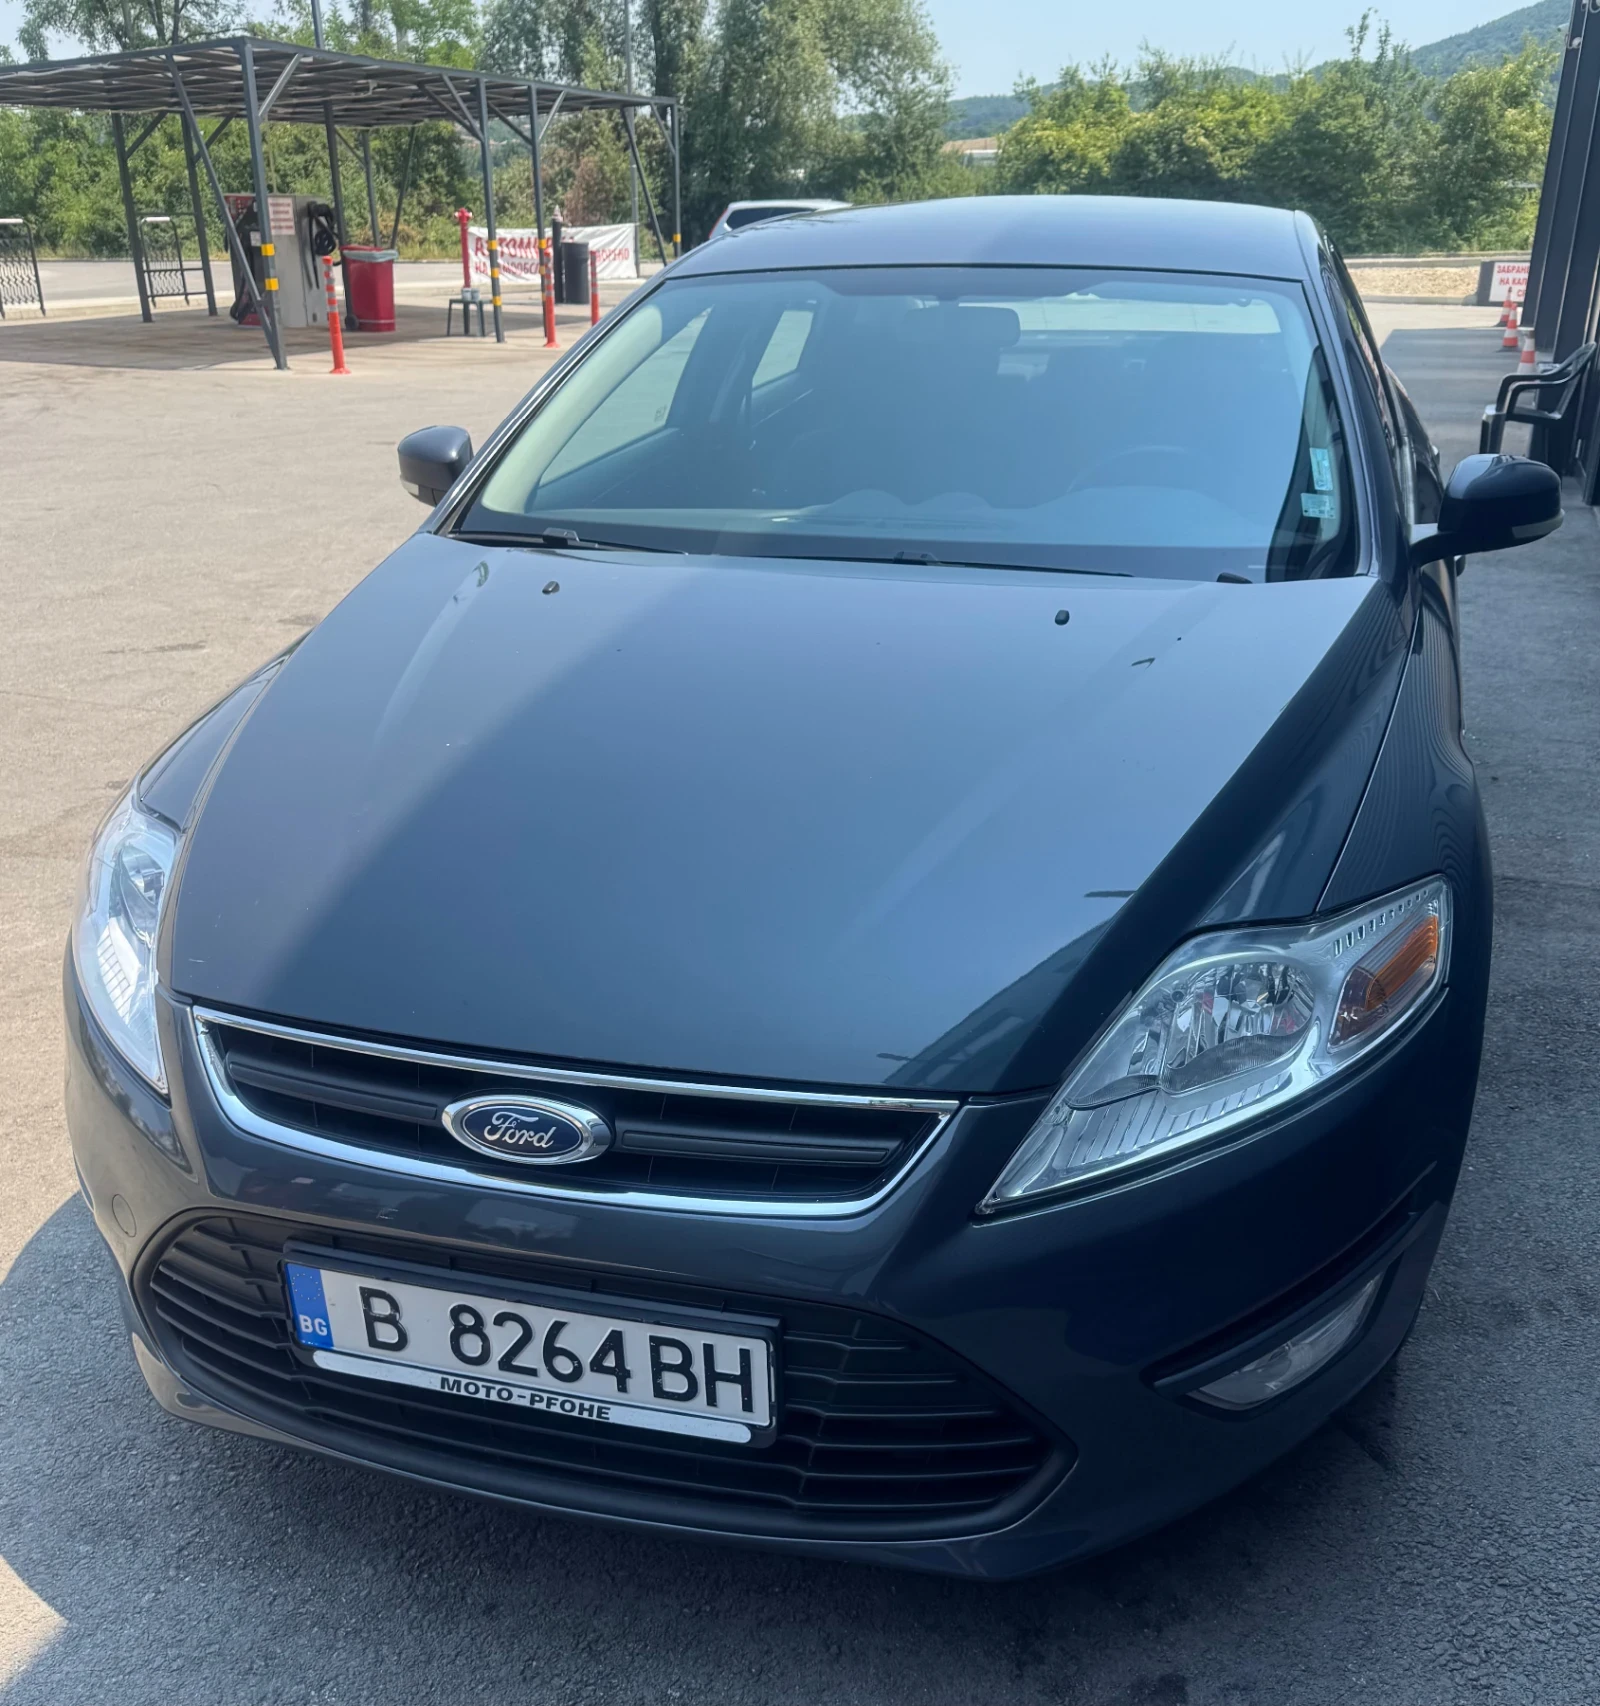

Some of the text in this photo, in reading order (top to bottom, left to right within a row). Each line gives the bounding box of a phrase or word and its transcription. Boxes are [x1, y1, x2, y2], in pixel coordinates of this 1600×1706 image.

[483, 1111, 557, 1148] Ford
[299, 1314, 329, 1337] BG
[358, 1286, 755, 1413] B 8264 BH
[440, 1376, 612, 1422] MOTO-PFOHE
